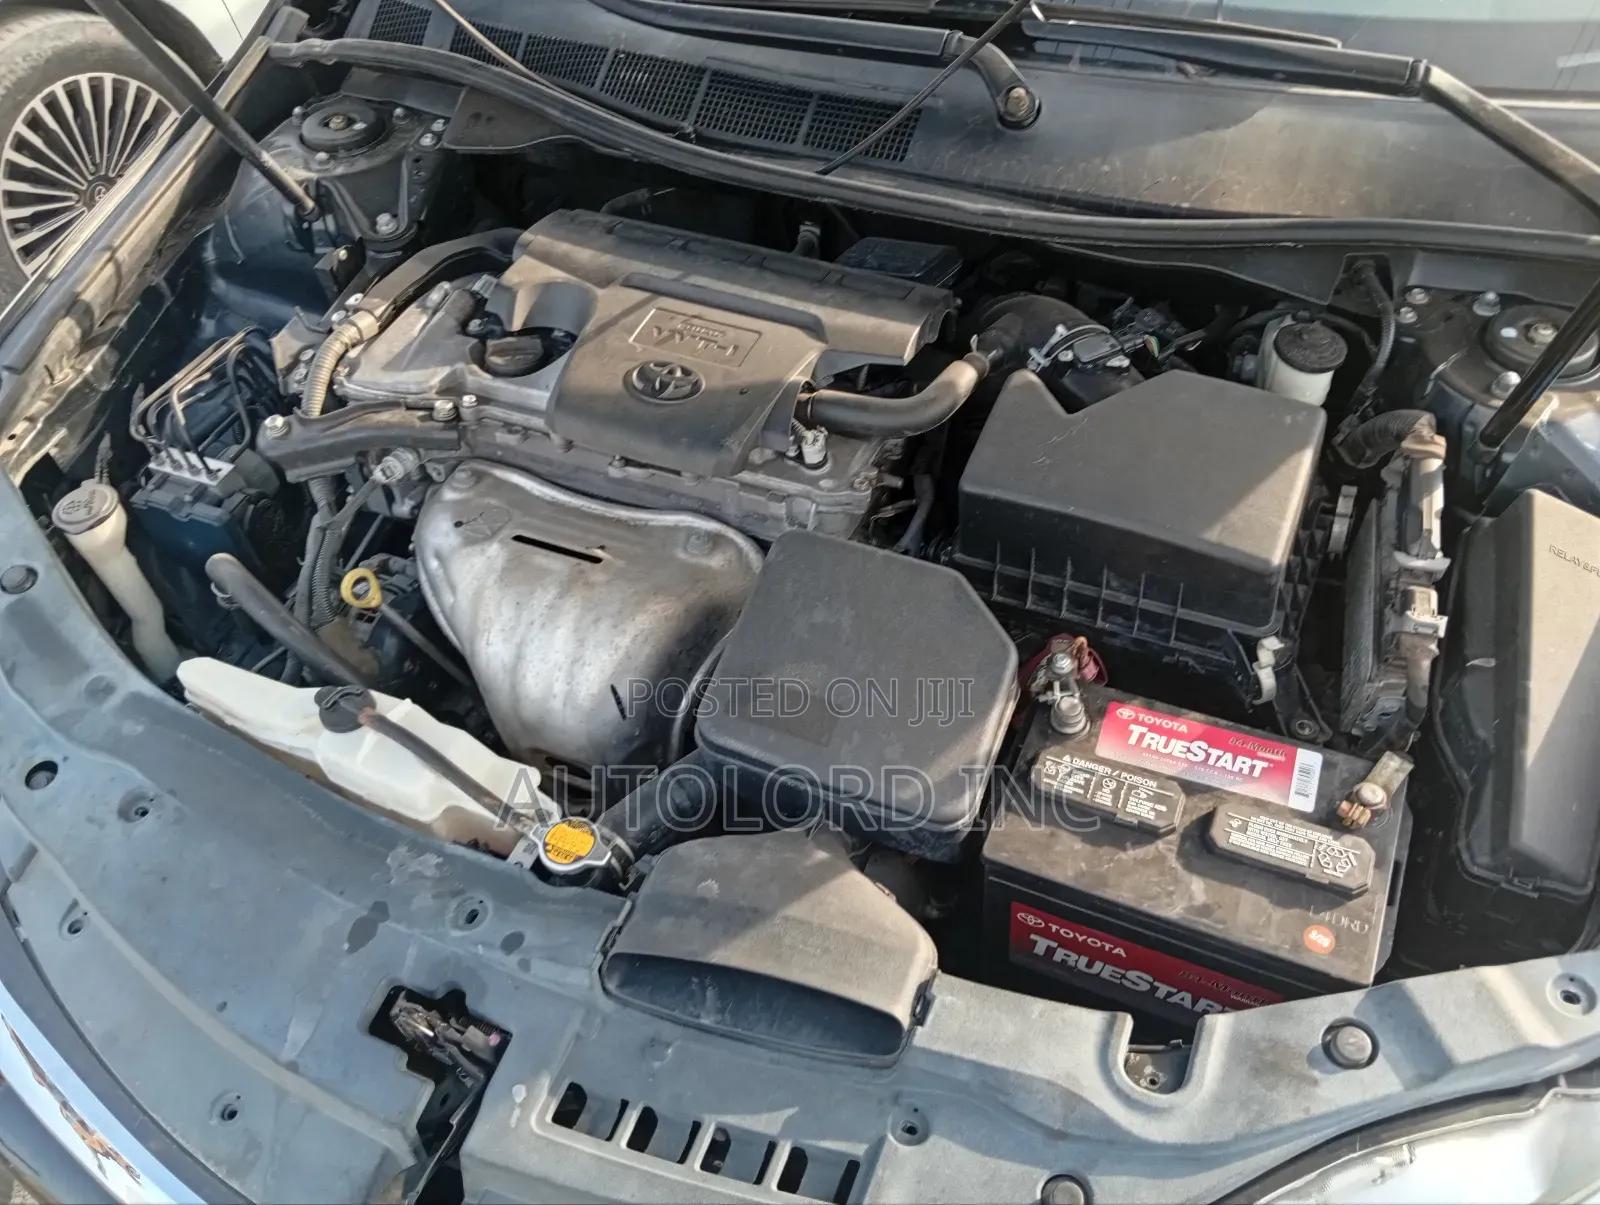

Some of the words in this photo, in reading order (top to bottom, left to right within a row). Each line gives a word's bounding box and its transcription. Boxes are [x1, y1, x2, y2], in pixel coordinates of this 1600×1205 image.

[1138, 713, 1188, 734] TOYOTA
[1073, 758, 1111, 776] DANGER
[1121, 771, 1157, 788] POISON
[1047, 923, 1128, 958] TOYOTA
